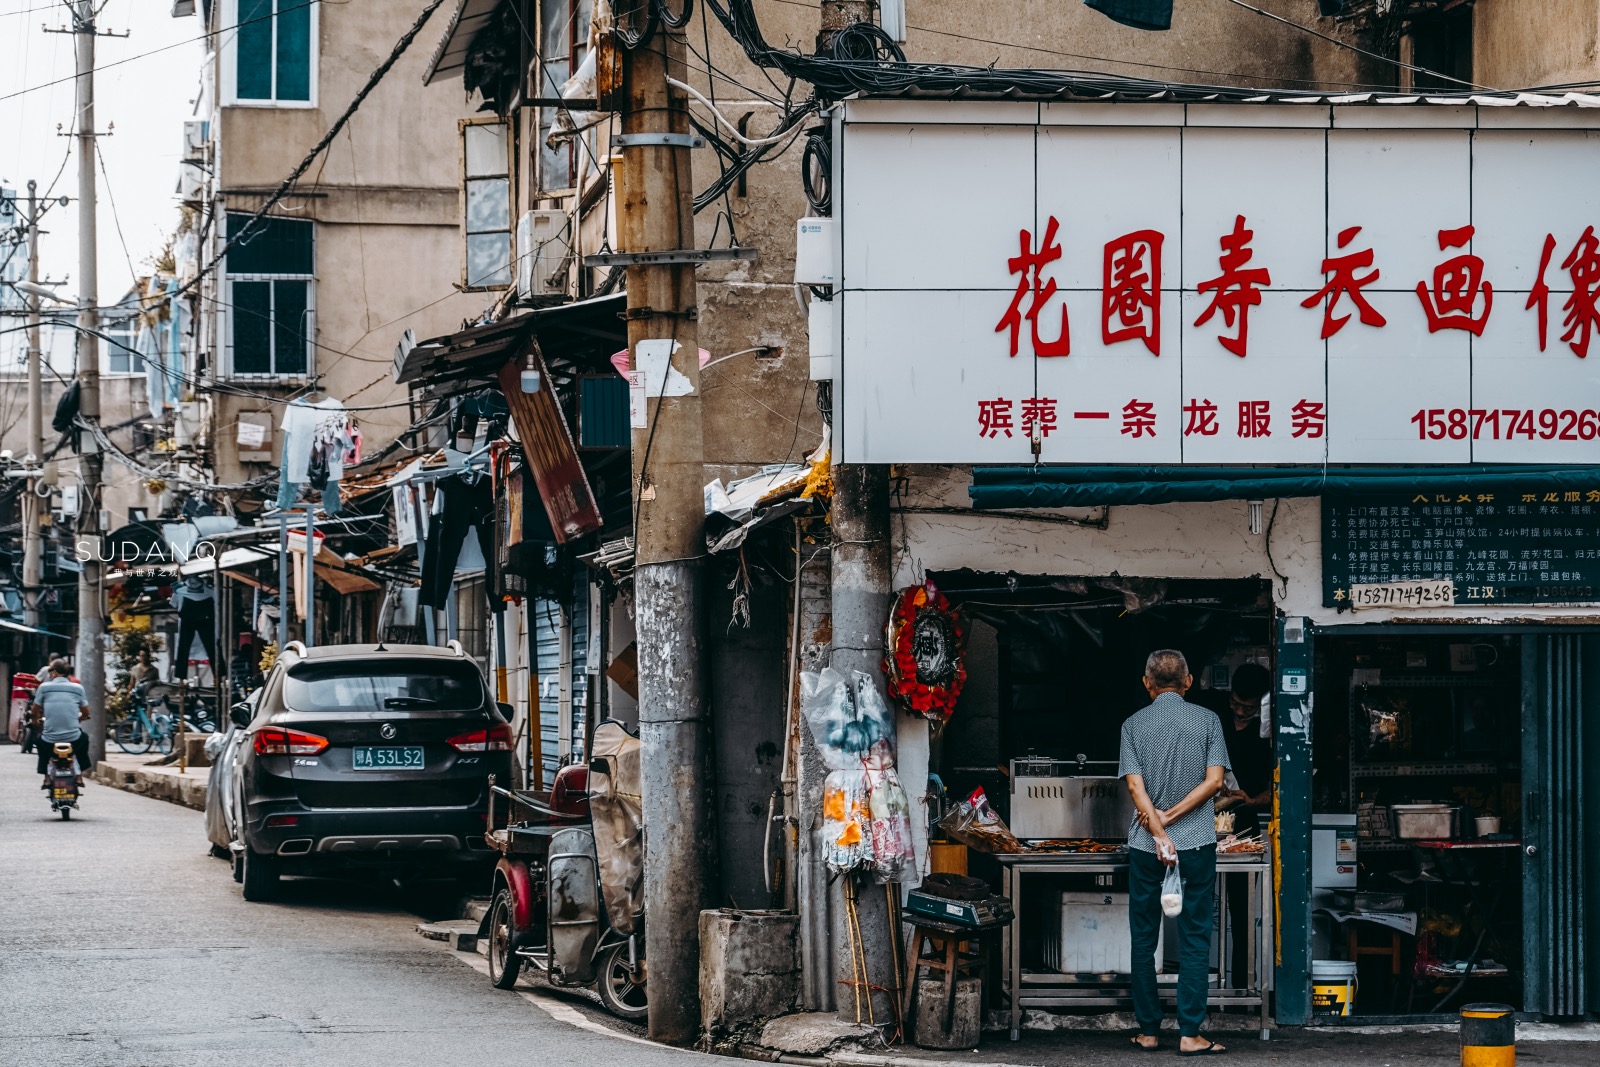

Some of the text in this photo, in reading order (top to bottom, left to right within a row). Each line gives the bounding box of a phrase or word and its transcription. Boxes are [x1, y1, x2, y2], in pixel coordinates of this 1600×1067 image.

[995, 215, 1600, 358] 花圈寿衣画像
[977, 397, 1327, 438] 殡葬一条龙服务
[1411, 408, 1600, 440] 1587174926
[1358, 585, 1450, 604] 15871749268
